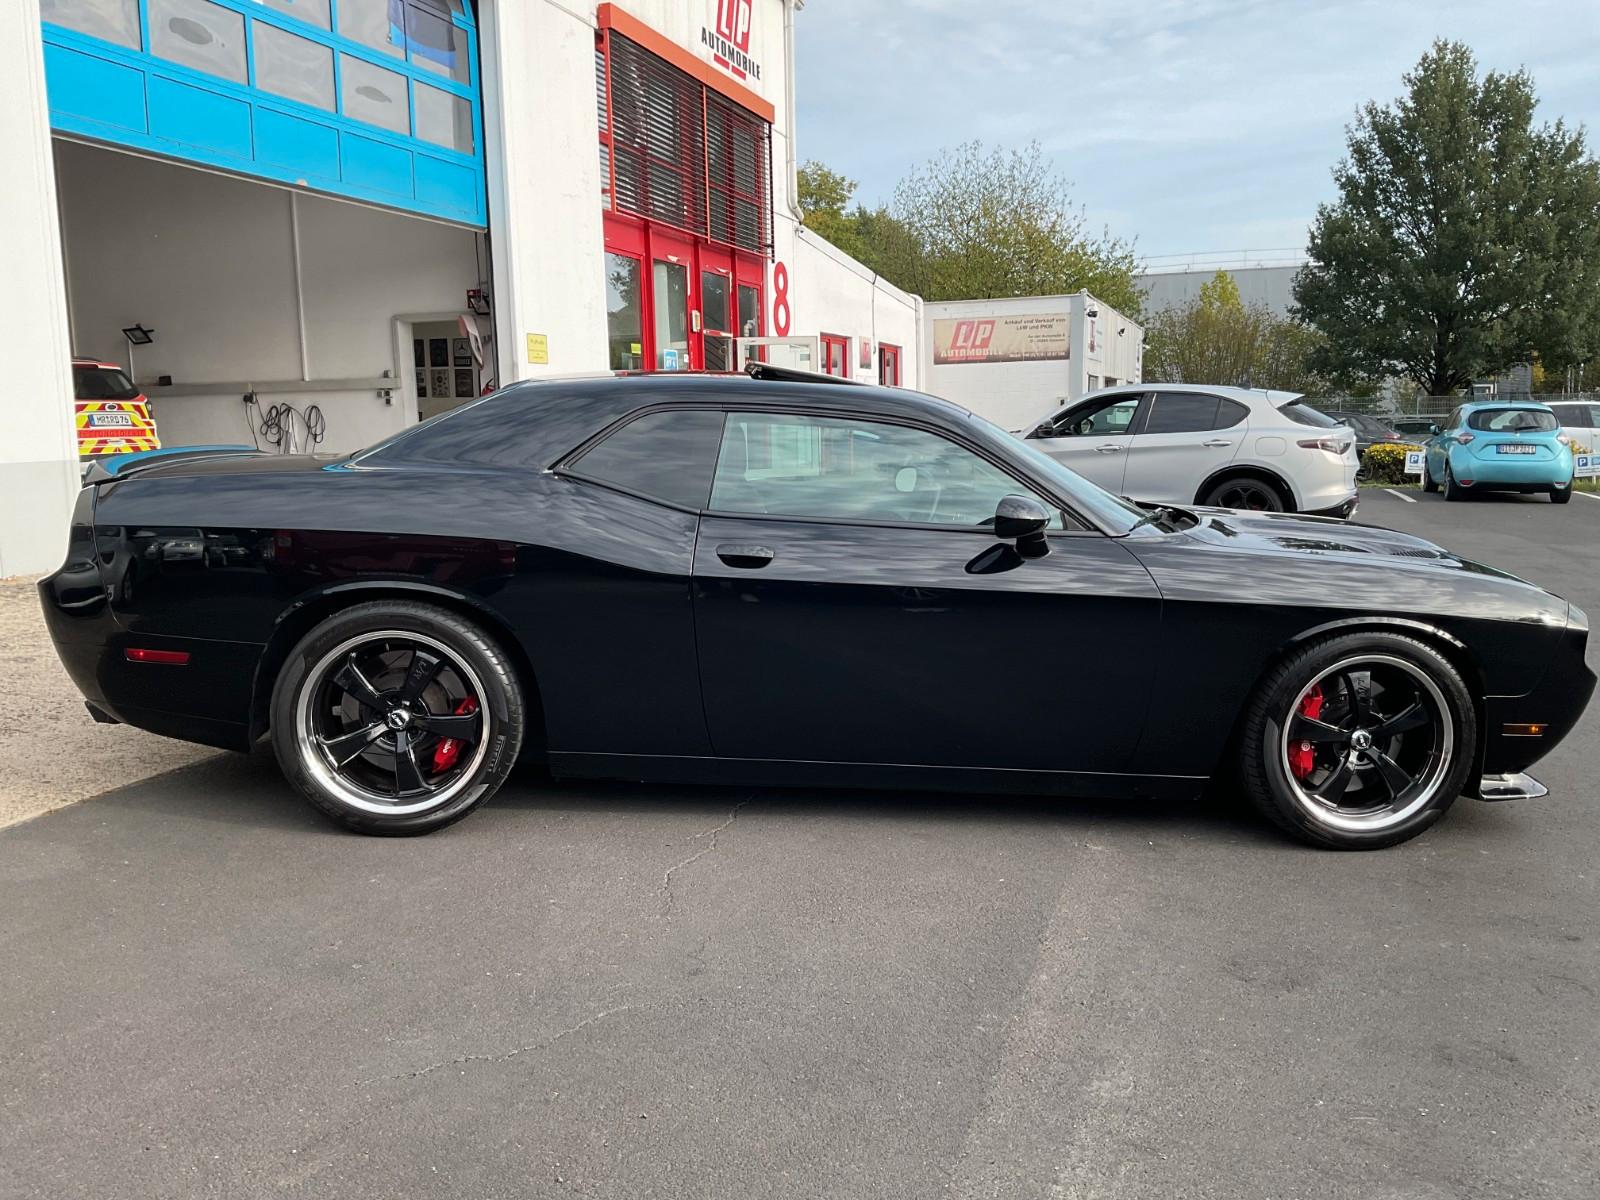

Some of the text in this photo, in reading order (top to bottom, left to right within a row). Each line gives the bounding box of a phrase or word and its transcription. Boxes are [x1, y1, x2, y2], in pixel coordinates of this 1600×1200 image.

[701, 26, 761, 80] AUTOMOBILE
[773, 261, 790, 337] 8
[954, 321, 993, 348] LP
